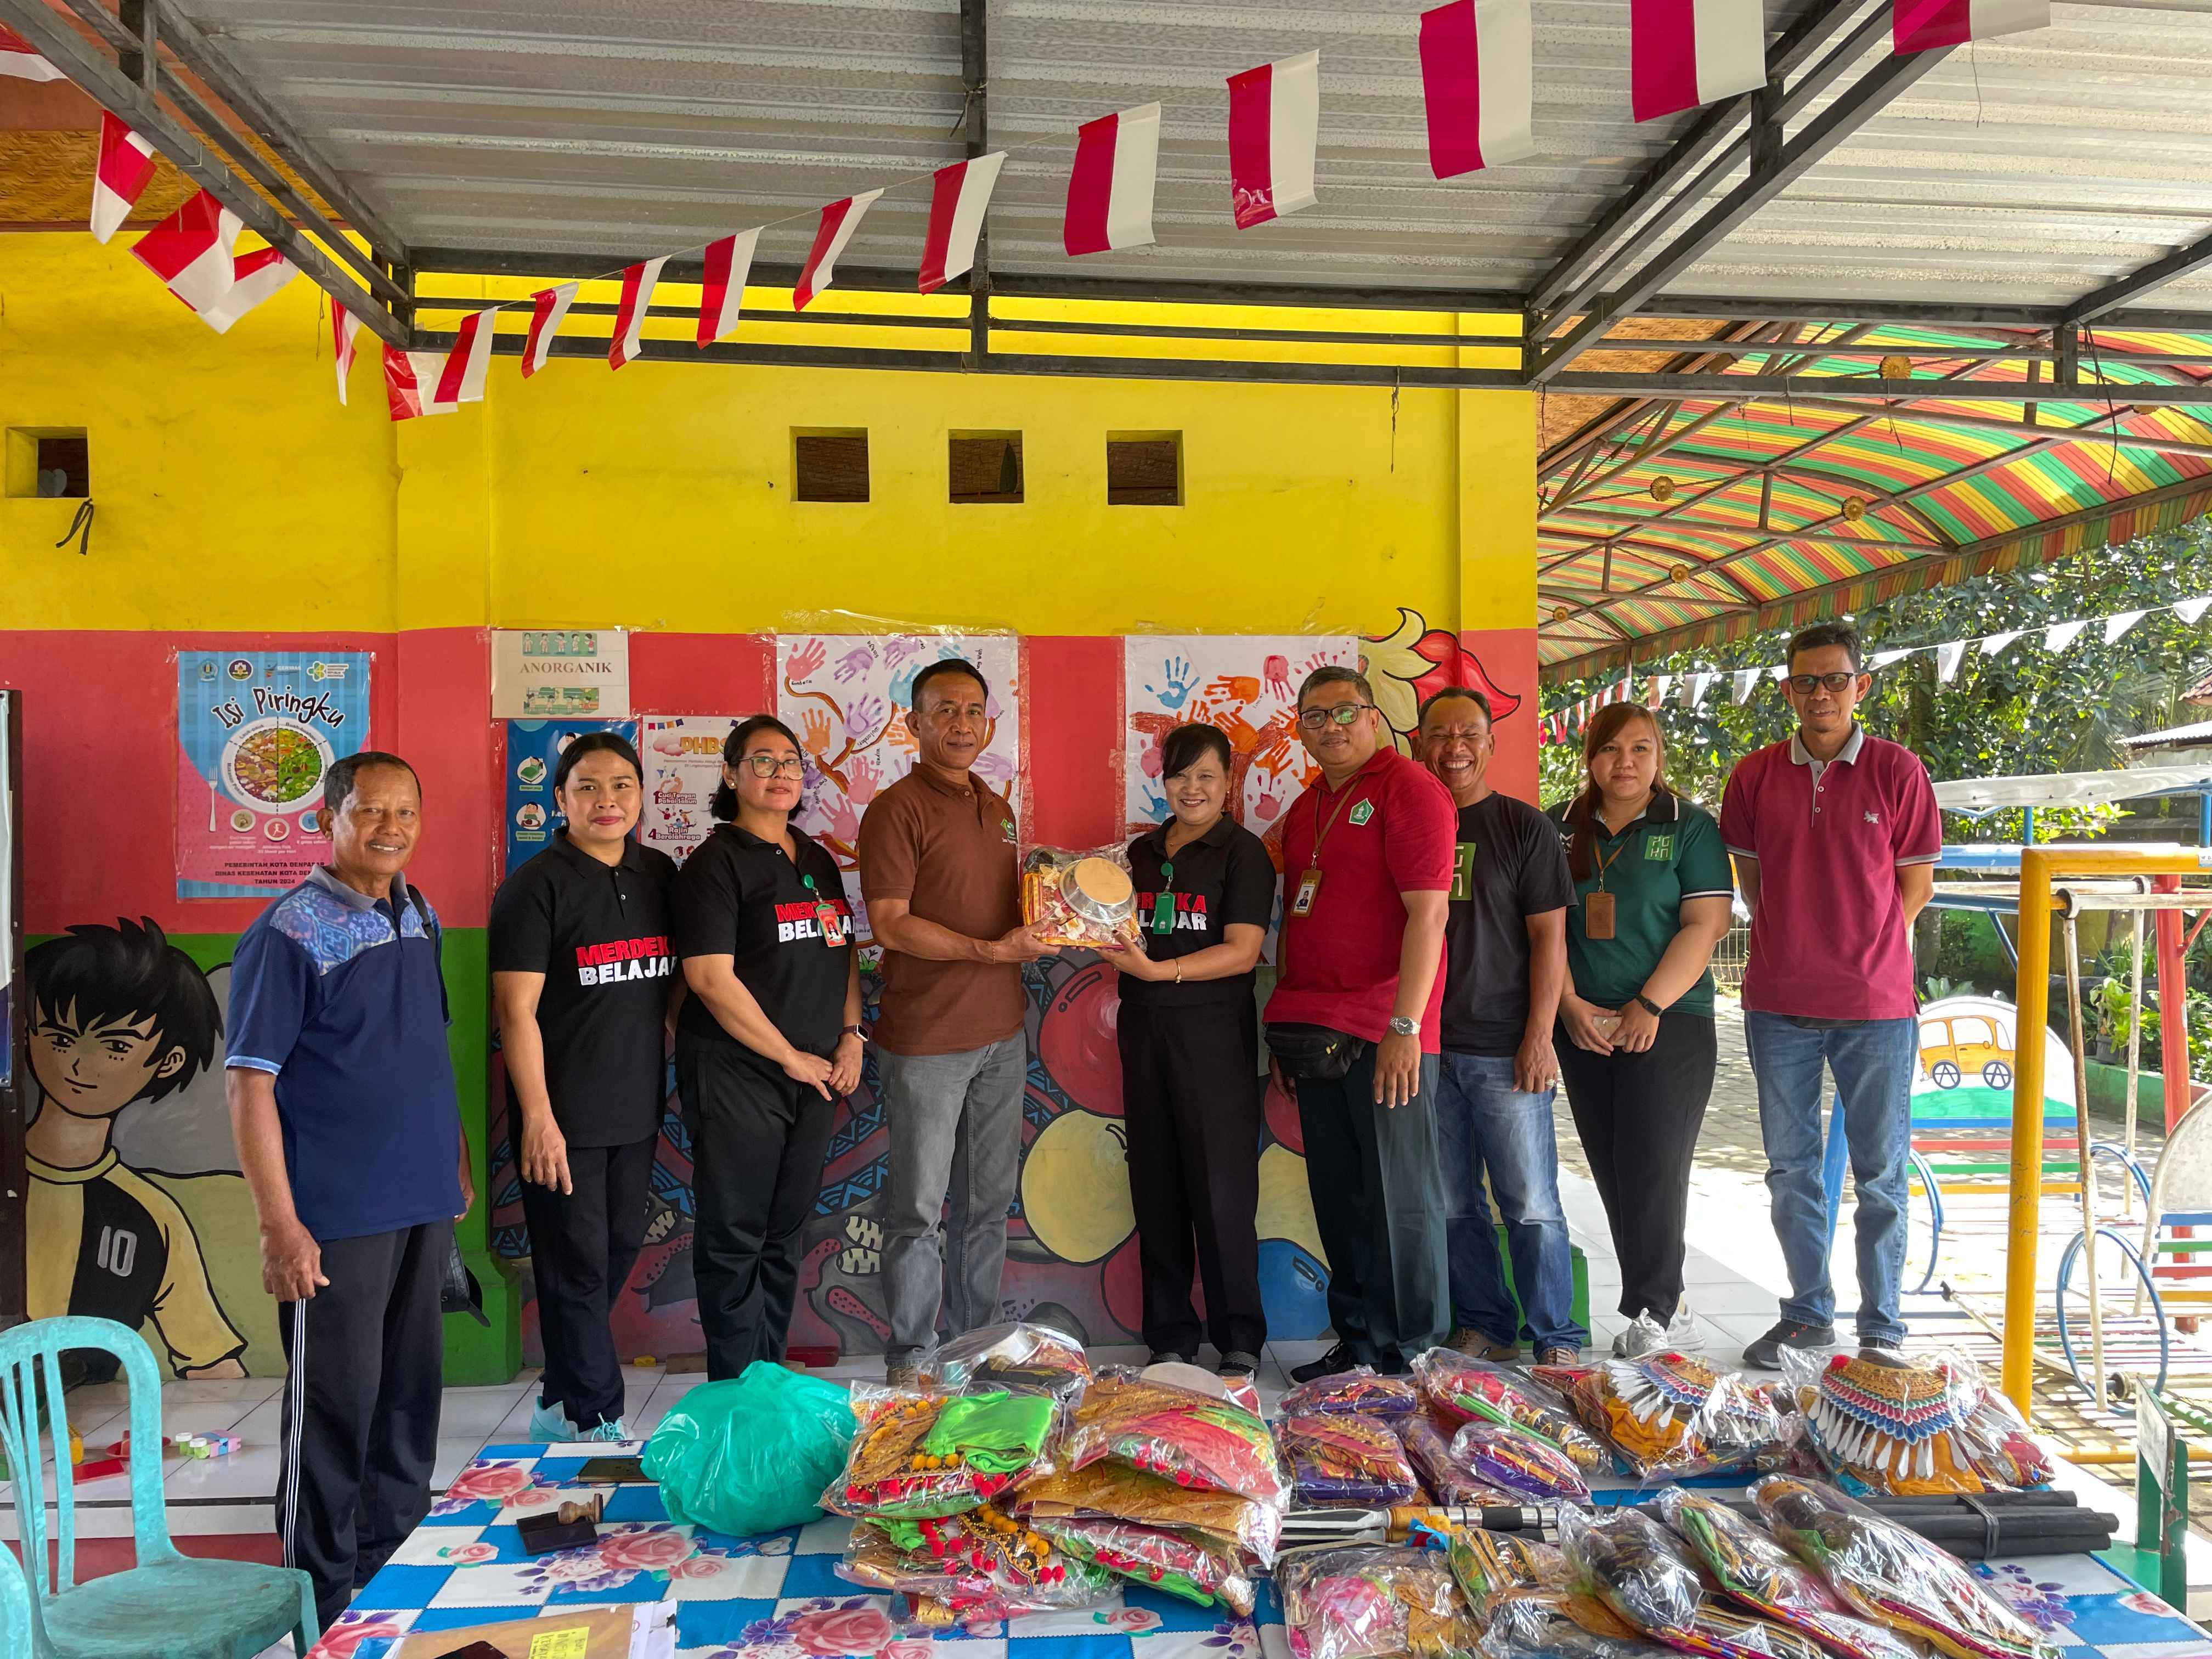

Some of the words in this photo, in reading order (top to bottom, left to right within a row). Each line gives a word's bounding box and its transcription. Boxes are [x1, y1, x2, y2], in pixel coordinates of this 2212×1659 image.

[520, 663, 612, 673] ANORGANIK
[252, 685, 345, 727] Piringku
[648, 828, 656, 839] 4
[97, 1225, 137, 1277] 10
